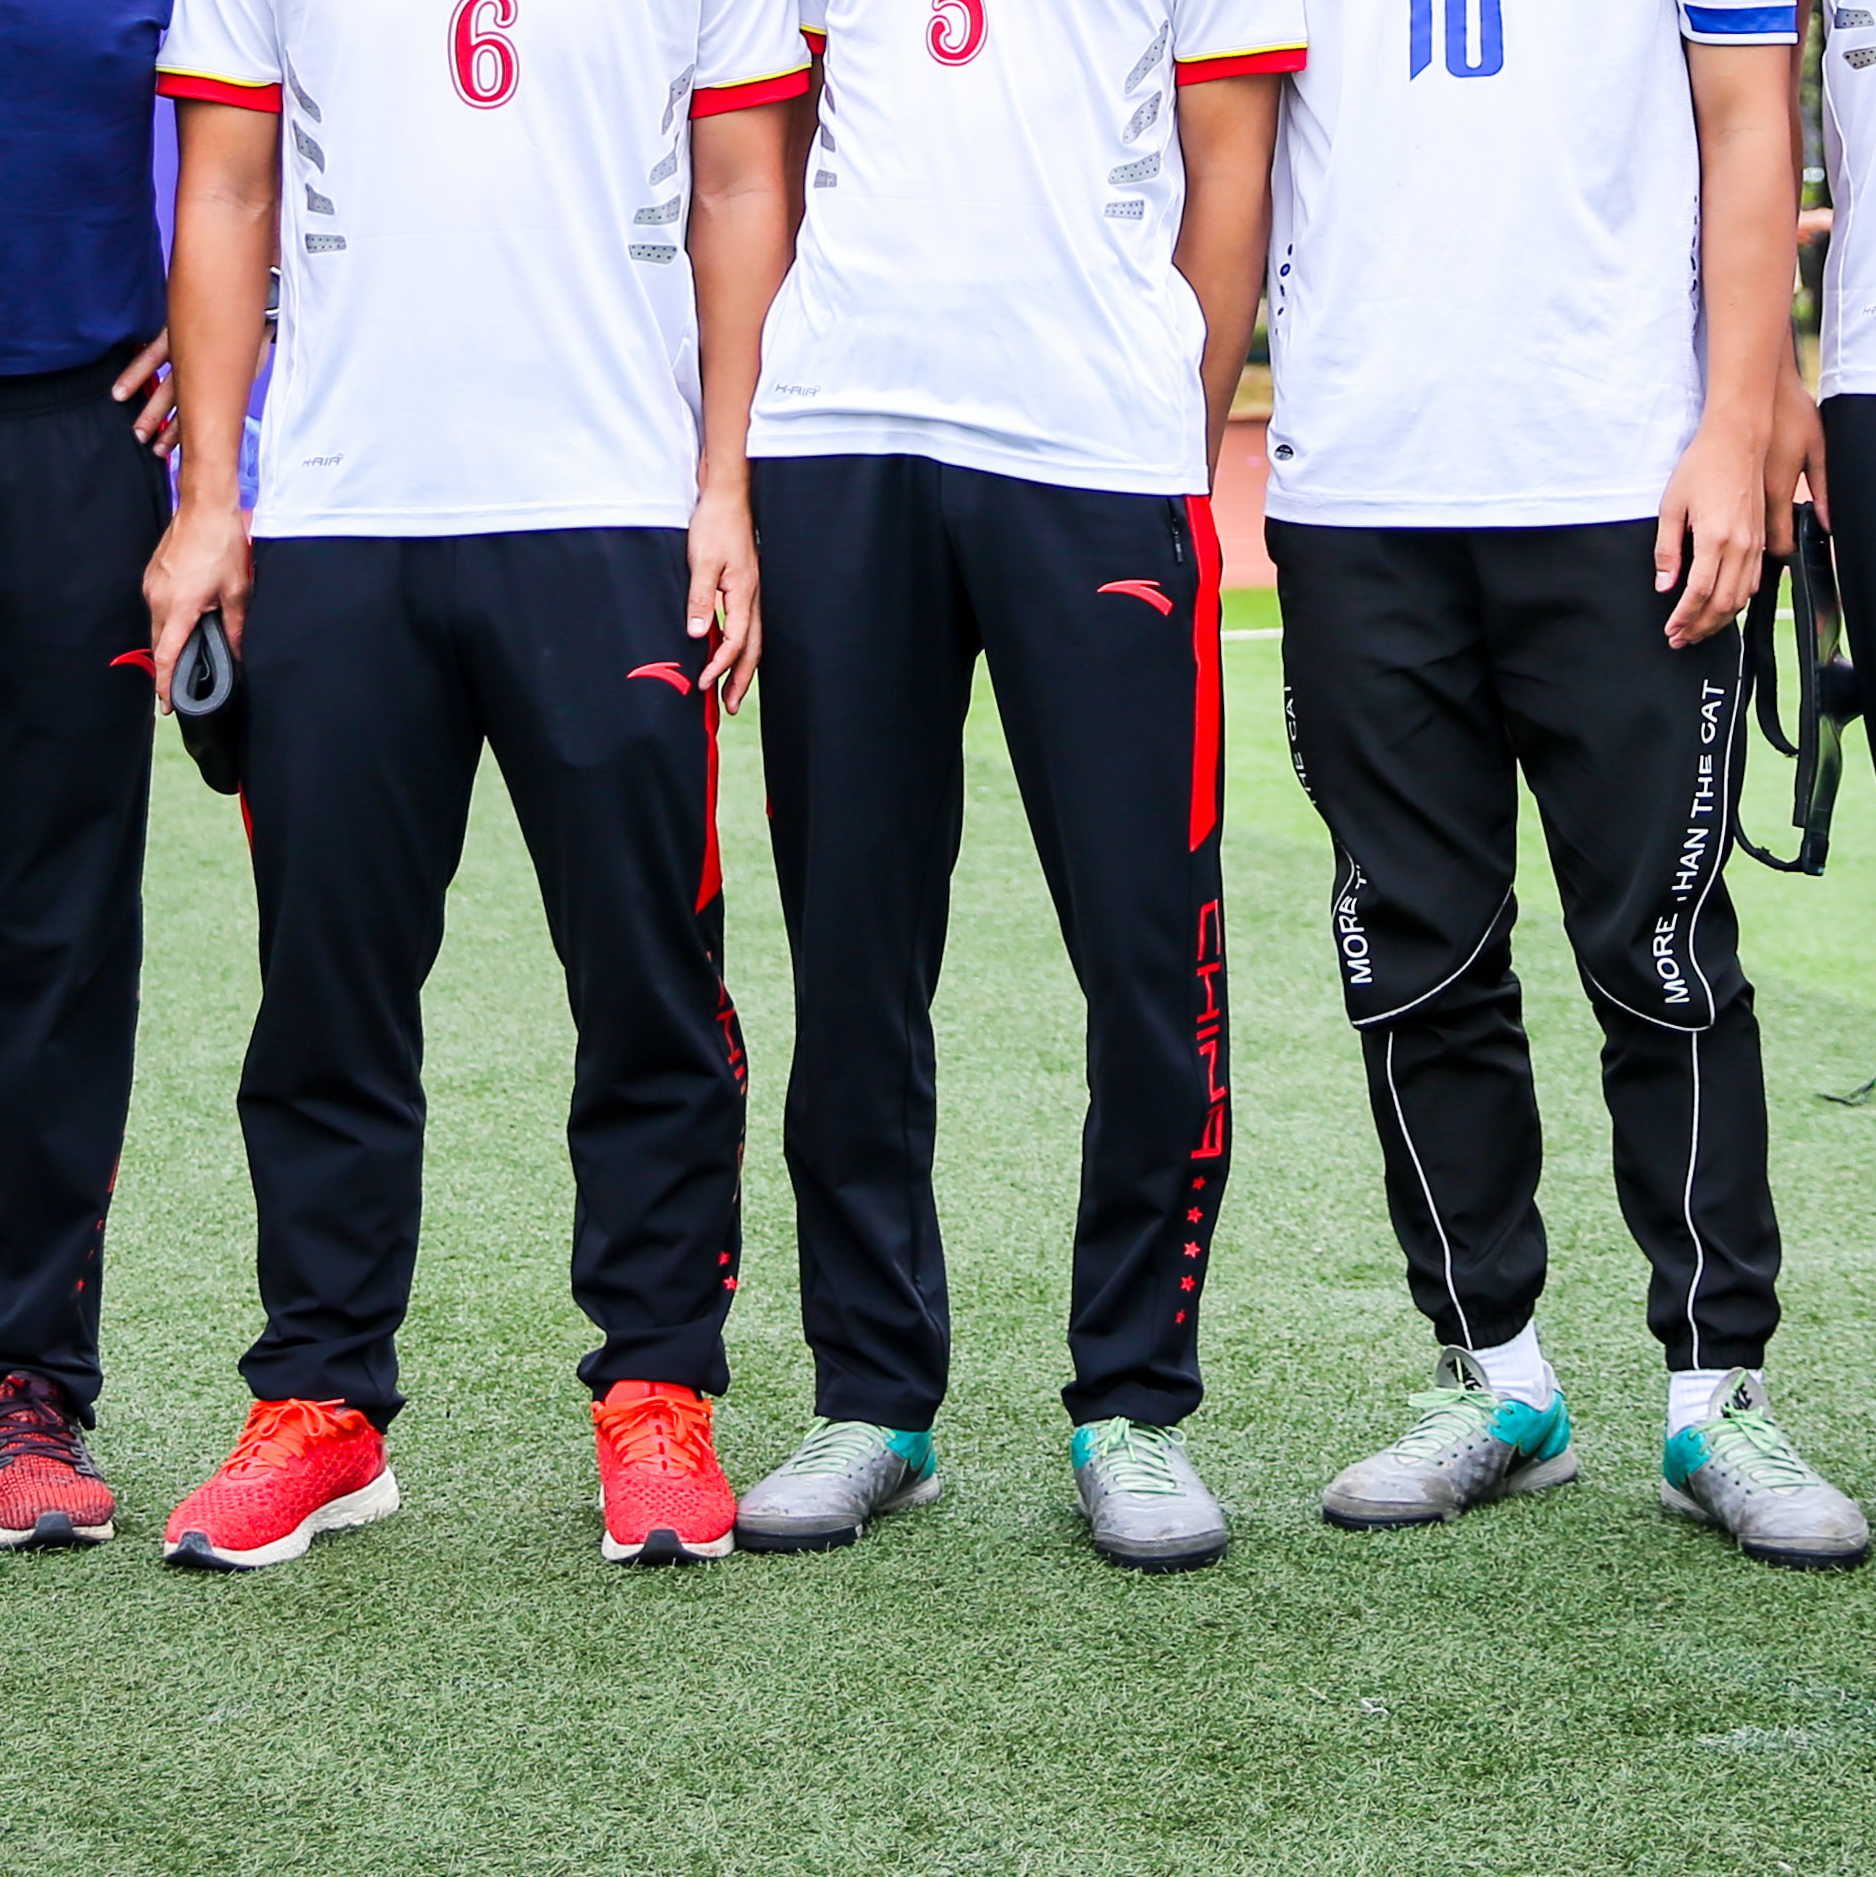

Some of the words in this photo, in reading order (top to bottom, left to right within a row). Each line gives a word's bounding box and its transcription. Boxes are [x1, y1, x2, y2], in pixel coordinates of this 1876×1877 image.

[1700, 679, 1725, 745] CAT
[1690, 753, 1715, 820] THE
[1671, 827, 1709, 901] HAN
[1338, 895, 1373, 985] MORE
[1653, 912, 1691, 1005] MORE
